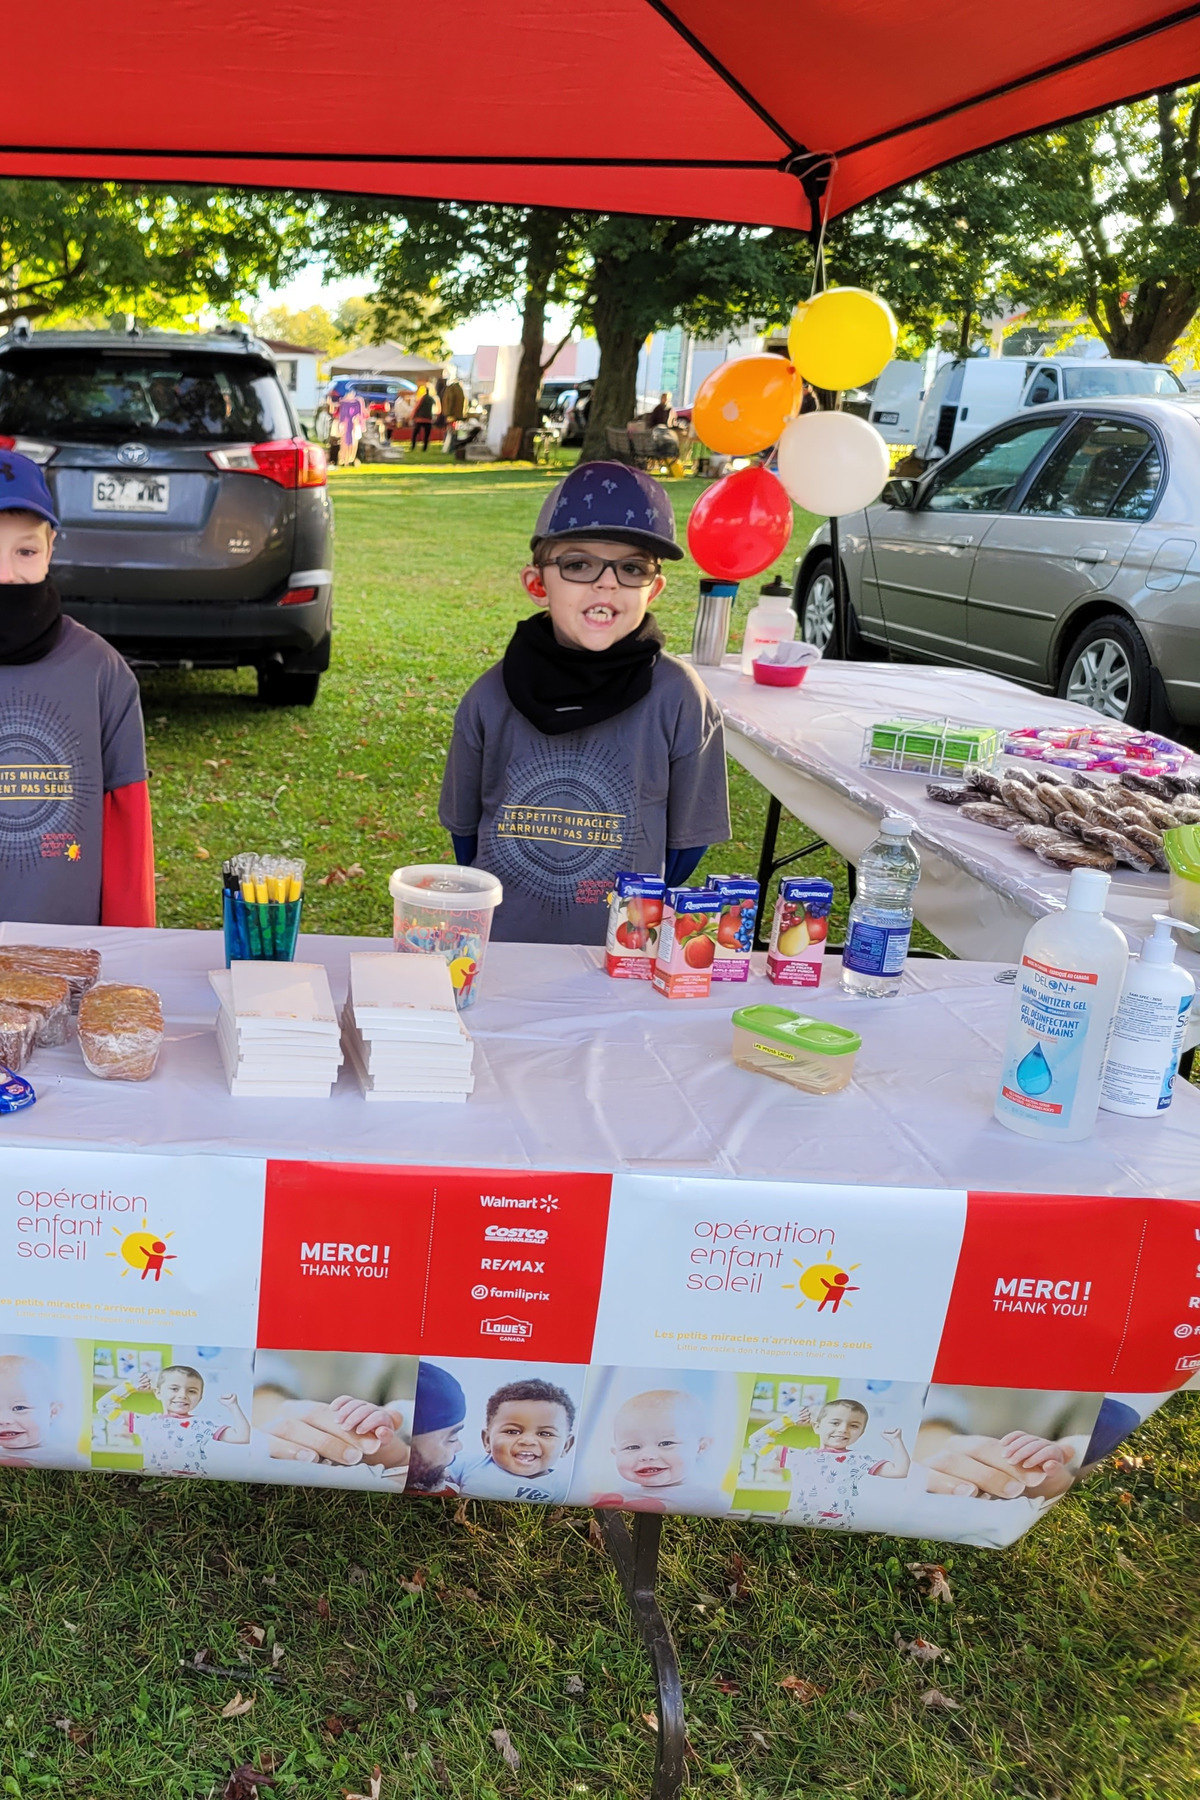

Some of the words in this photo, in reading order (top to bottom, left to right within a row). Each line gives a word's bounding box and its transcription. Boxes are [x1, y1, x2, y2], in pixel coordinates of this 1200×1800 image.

[20, 770, 70, 781] MIRACLES
[21, 784, 41, 794] PAS
[44, 784, 74, 794] SEULS
[504, 811, 524, 821] LES
[526, 813, 563, 823] PETITS
[564, 816, 619, 830] MIRACLES
[497, 822, 562, 836] N'ARRIVENT
[563, 826, 582, 840] PAS
[587, 832, 623, 843] SEULS
[720, 887, 757, 897] Rougemont
[790, 889, 830, 899] Rougemont
[1022, 984, 1037, 998] HAND
[1038, 991, 1071, 1009] SANITIZER
[1073, 1001, 1087, 1010] GEL
[1021, 1004, 1030, 1016] GEL
[1030, 1009, 1080, 1030] DÉSINFECTANT
[1021, 1014, 1035, 1028] POUR
[1035, 1022, 1046, 1033] LES
[1047, 1026, 1074, 1038] MAINS
[17, 1187, 148, 1213] opération
[480, 1195, 538, 1209] Walmart
[17, 1213, 103, 1236] enfant
[484, 1225, 549, 1239] COSTCO
[694, 1219, 835, 1245] opération
[16, 1240, 86, 1261] soleil
[690, 1246, 784, 1268] enfant
[300, 1263, 351, 1277] THANK
[355, 1265, 389, 1278] YOU!
[481, 1258, 545, 1273] RE/MAX
[686, 1273, 762, 1293] soleil
[490, 1287, 550, 1302] familiprix
[15, 1297, 44, 1308] petits
[47, 1299, 92, 1310] miracles
[94, 1302, 145, 1314] n'arrivent
[148, 1306, 166, 1316] pas
[170, 1307, 198, 1317] seuls
[993, 1299, 1048, 1315] THANK
[1051, 1303, 1088, 1316] YOU!
[654, 1329, 674, 1339] Les
[677, 1331, 708, 1342] petits
[711, 1332, 759, 1343] miracles
[762, 1335, 816, 1347] n'arrivent
[819, 1340, 839, 1350] pas
[842, 1340, 873, 1350] seuls
[677, 1343, 698, 1351] Little
[700, 1345, 736, 1353] miracles
[738, 1346, 759, 1354] don't
[760, 1347, 791, 1358] happen
[793, 1349, 804, 1357] on
[806, 1350, 825, 1359] their
[827, 1352, 846, 1360] own
